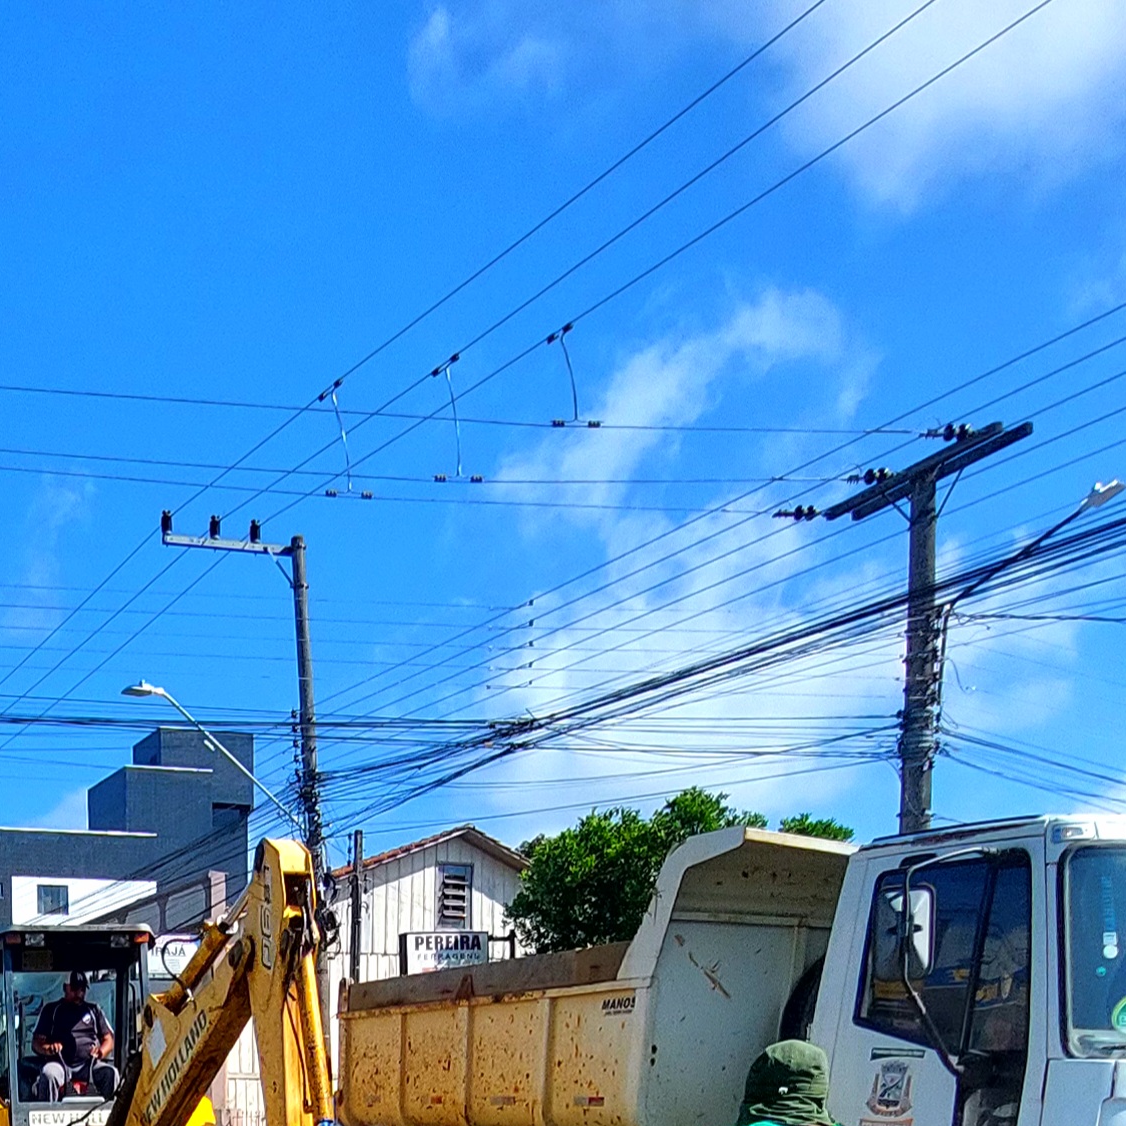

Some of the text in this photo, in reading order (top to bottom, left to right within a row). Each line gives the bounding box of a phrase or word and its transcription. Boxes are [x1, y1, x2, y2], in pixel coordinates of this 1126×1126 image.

[415, 935, 482, 951] PEREIRA
[159, 1009, 208, 1095] HOLLAND
[32, 1112, 105, 1125] NEW HLL
